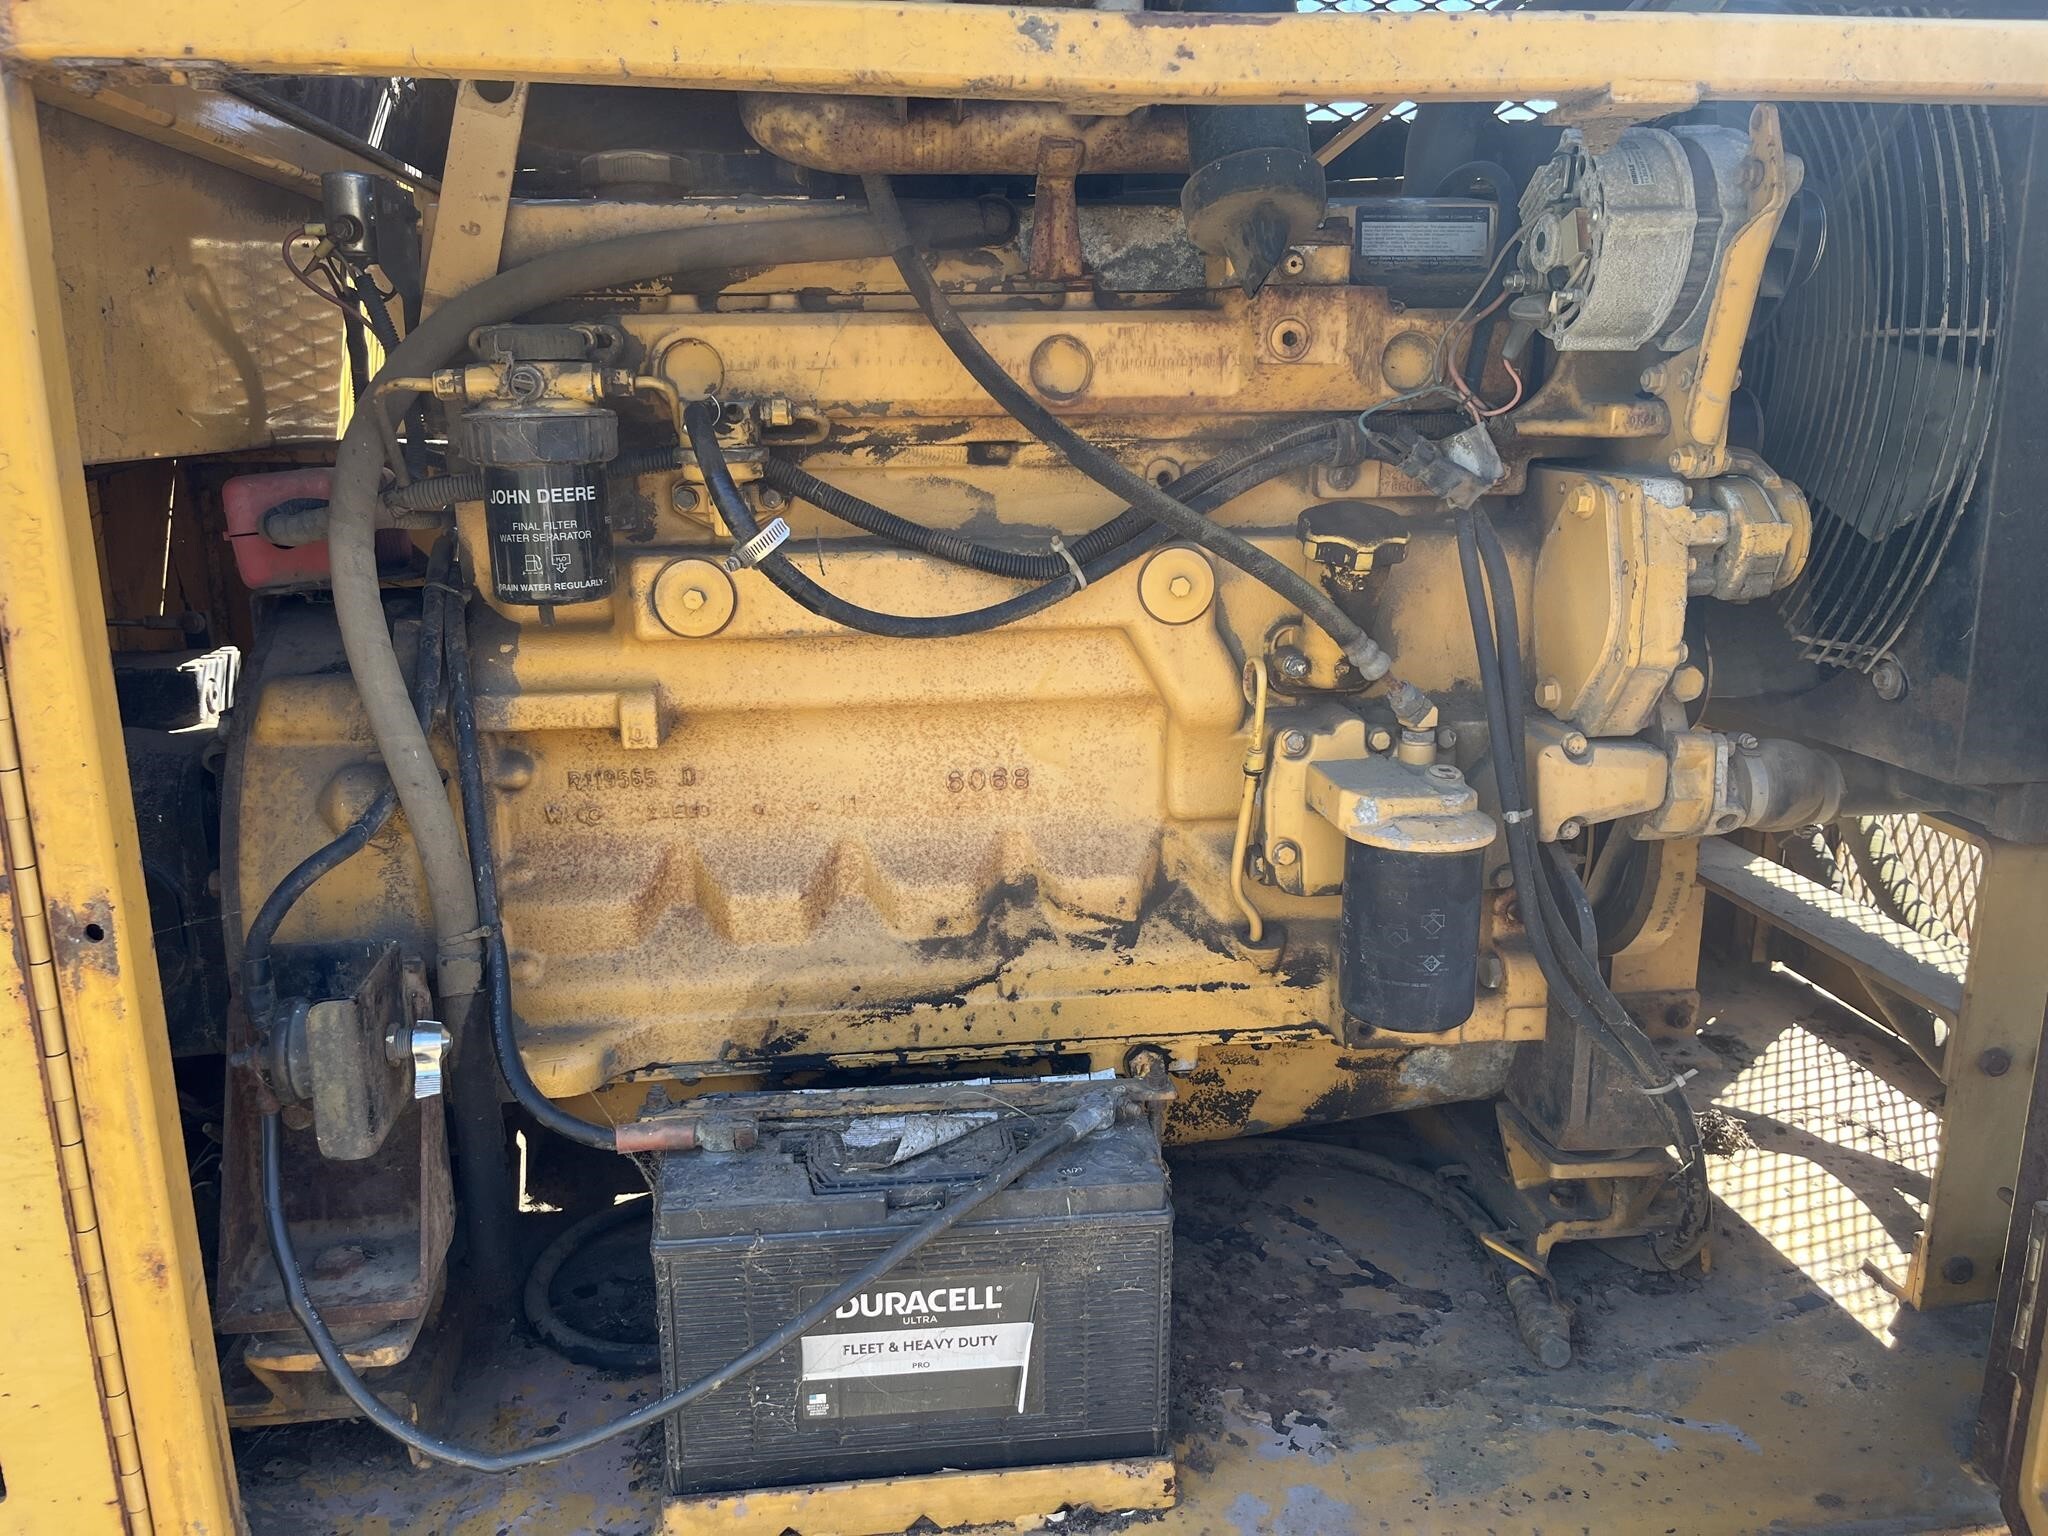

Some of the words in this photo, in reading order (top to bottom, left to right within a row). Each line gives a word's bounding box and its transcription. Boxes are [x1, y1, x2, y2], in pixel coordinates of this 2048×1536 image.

[490, 489, 531, 504] JOHN
[537, 486, 596, 503] DEERE
[512, 522, 540, 531] FINAL
[543, 519, 578, 530] FILTER
[500, 533, 529, 542] WATER
[532, 530, 592, 542] SEPARATOR
[520, 583, 551, 592] WATER
[946, 766, 1029, 793] 6068
[836, 1285, 1002, 1319] DURACELL
[902, 1315, 938, 1325] ULTRA
[843, 1342, 884, 1356] FLEET
[888, 1341, 899, 1353] &
[903, 1338, 952, 1352] HEAVY
[958, 1335, 999, 1348] DUTY
[912, 1361, 930, 1369] PRO
